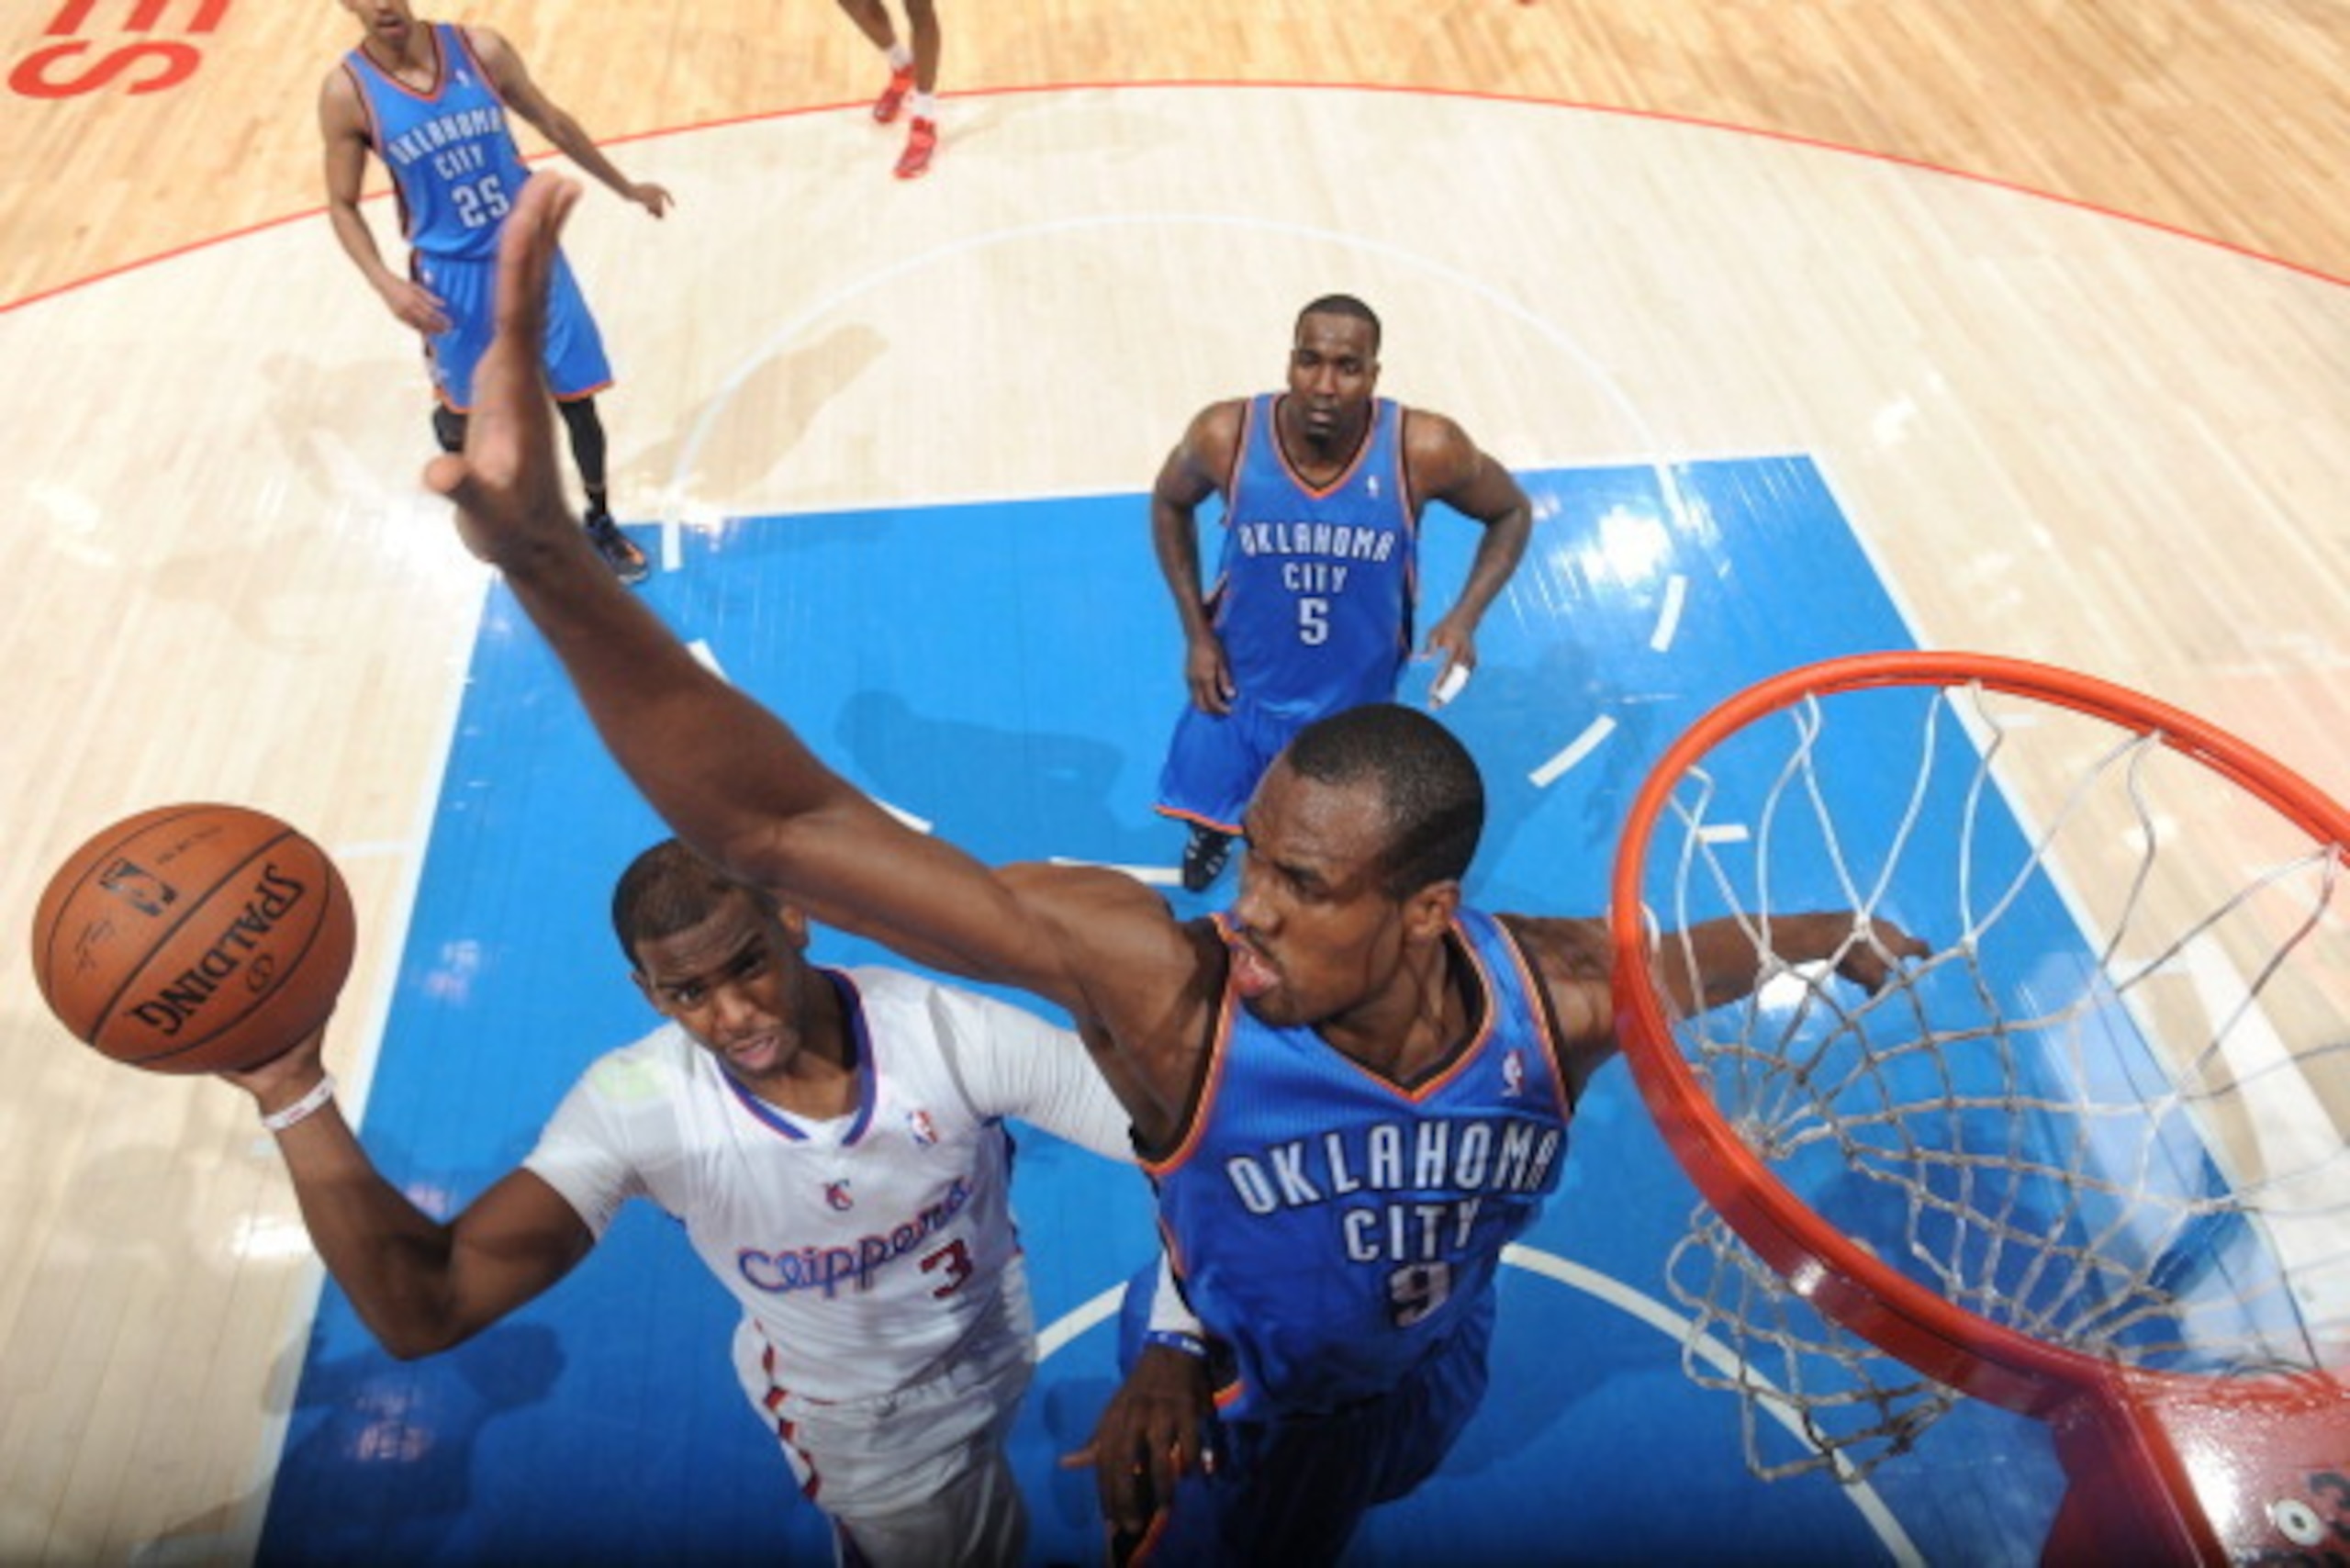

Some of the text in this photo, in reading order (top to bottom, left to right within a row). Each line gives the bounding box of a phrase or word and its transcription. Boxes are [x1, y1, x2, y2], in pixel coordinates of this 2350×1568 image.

[433, 143, 486, 181] CITY
[451, 174, 509, 229] 25
[1239, 521, 1395, 562] OKLAHOMA
[1282, 562, 1348, 593] CITY
[1298, 597, 1329, 646] 5
[126, 863, 307, 1036] SPALDING
[1225, 1119, 1559, 1215] OKLAHOMA
[1342, 1197, 1480, 1262] CITY
[919, 1238, 974, 1299] 3
[1389, 1260, 1451, 1328] 9
